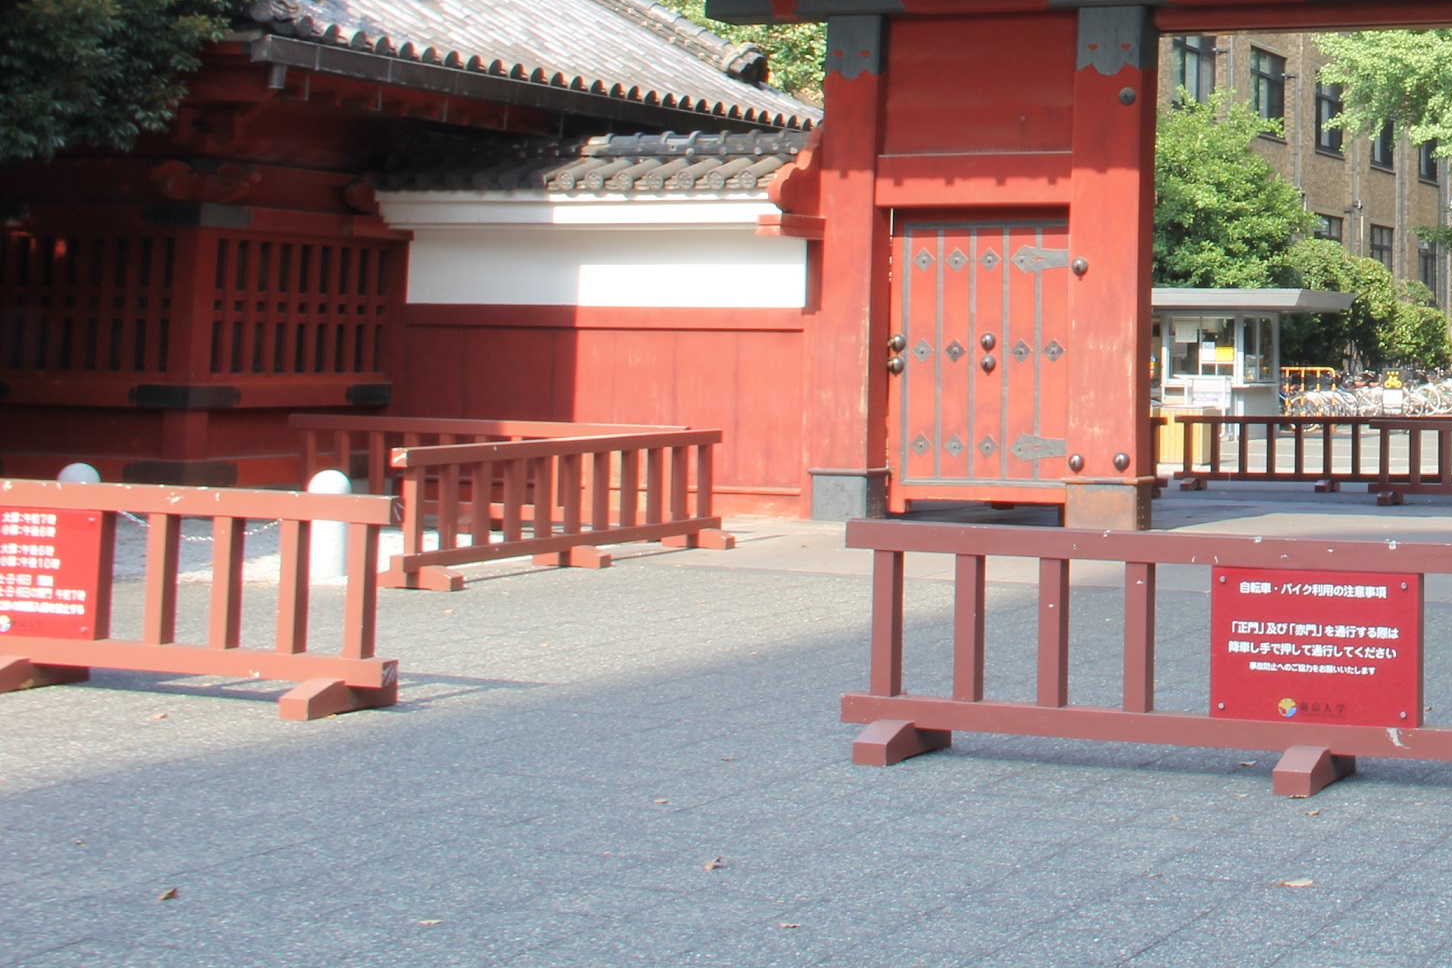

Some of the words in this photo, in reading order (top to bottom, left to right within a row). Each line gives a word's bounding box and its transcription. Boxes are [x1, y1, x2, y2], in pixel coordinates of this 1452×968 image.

[1239, 581, 1387, 599] 自転車・バイク利用の注意事項
[1231, 620, 1399, 640] 「正門」及び「赤門」を通行する際は
[1228, 640, 1397, 659] 降車し手で押して通行してください
[1249, 661, 1376, 676] 事故防止へのご協力をお願いいたします
